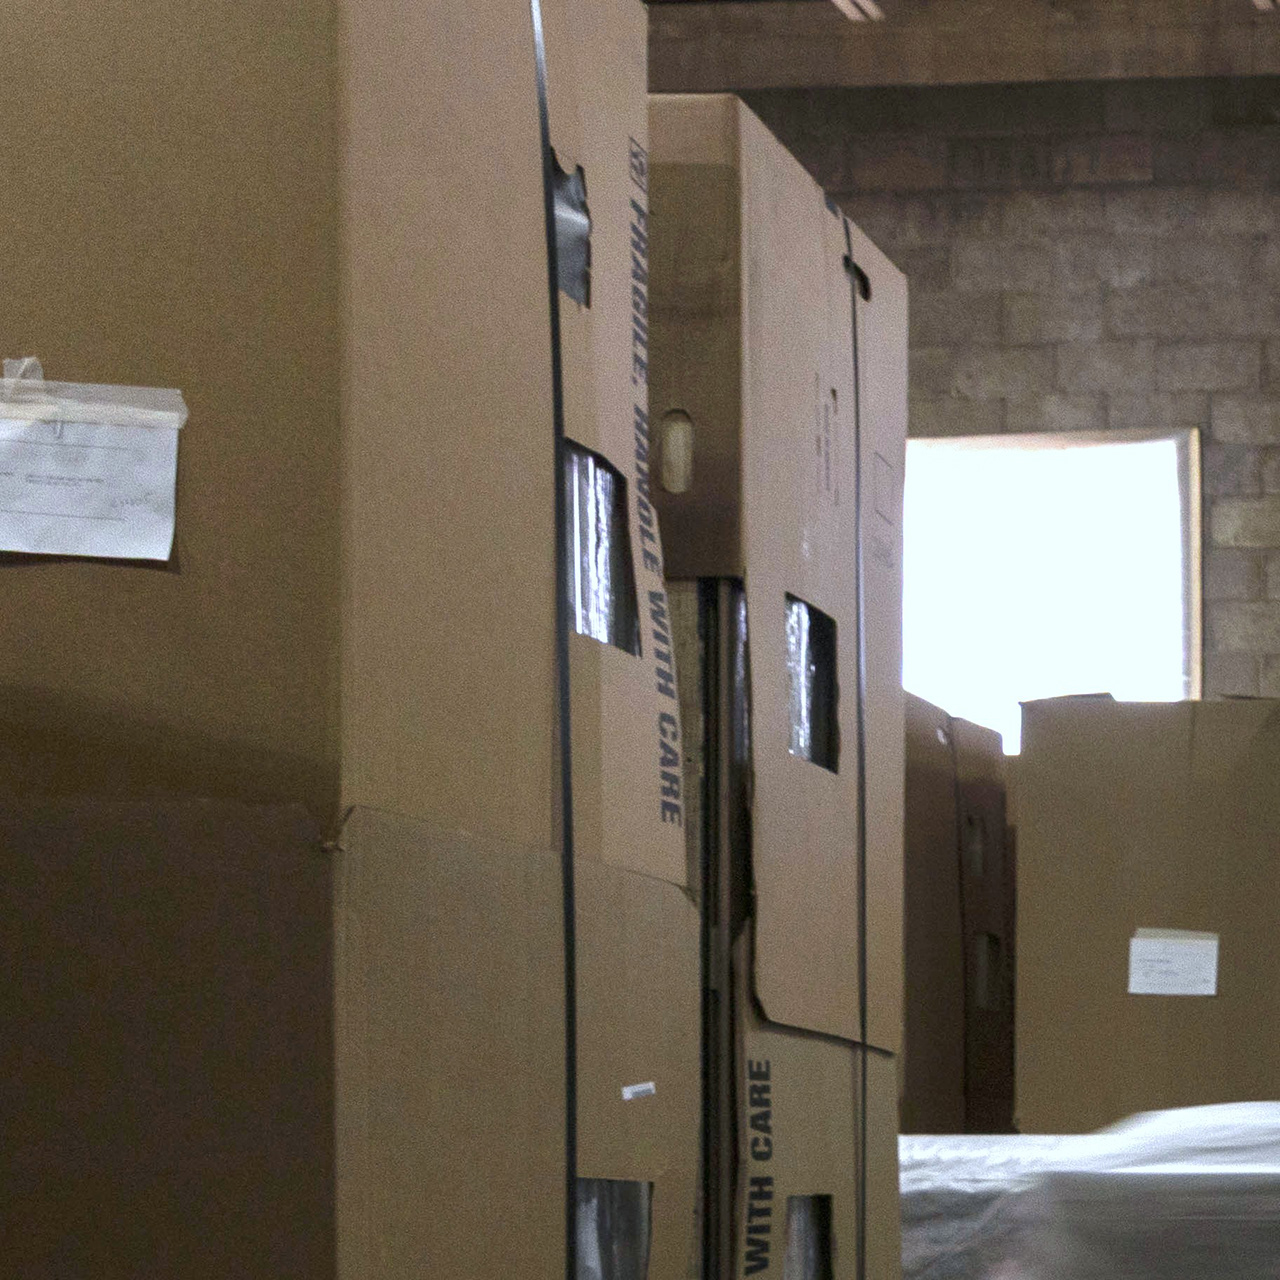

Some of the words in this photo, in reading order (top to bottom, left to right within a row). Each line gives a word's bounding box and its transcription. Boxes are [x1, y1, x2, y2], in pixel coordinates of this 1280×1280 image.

[630, 198, 649, 387] FRAGILE,
[633, 403, 661, 576] HANDLE
[648, 589, 677, 700] WITH
[658, 711, 684, 828] CARE
[748, 1059, 773, 1163] CARE
[744, 1176, 774, 1277] WITH
